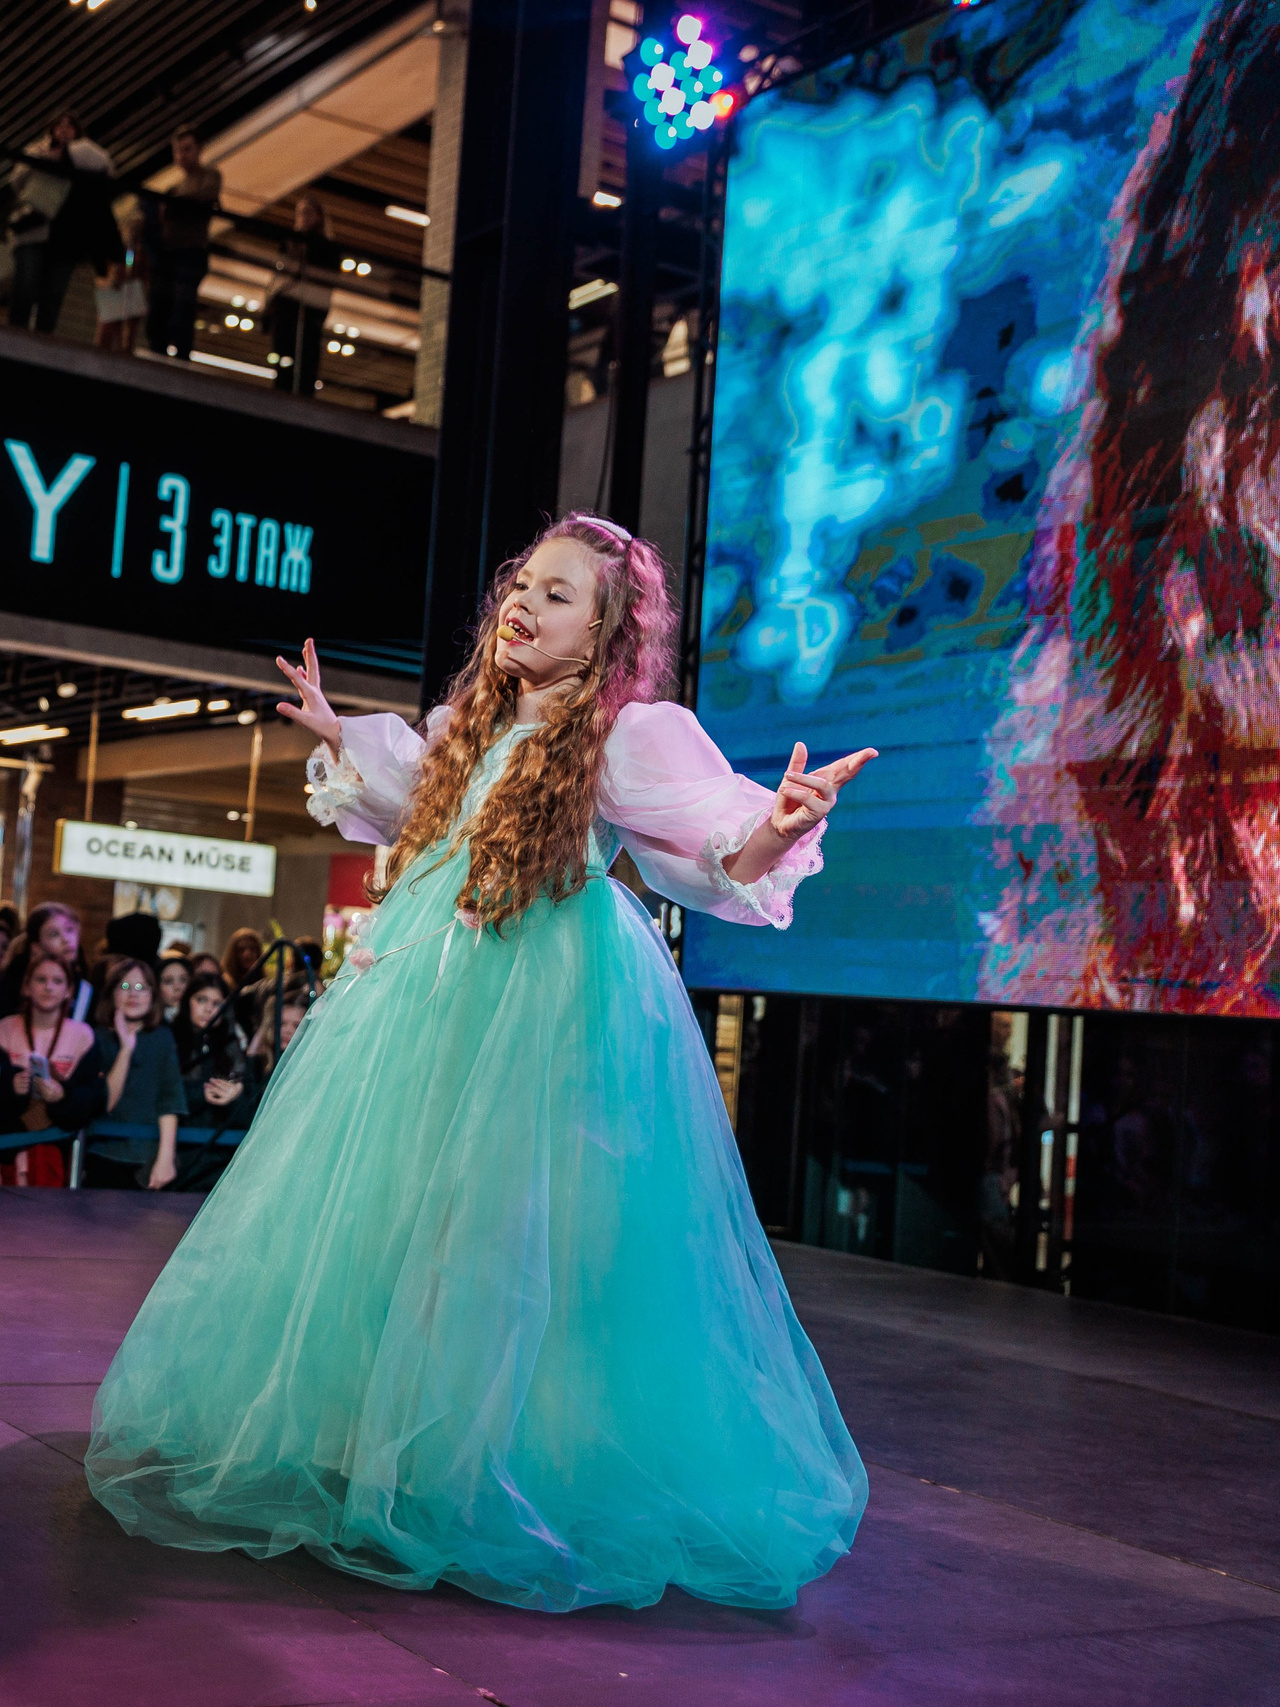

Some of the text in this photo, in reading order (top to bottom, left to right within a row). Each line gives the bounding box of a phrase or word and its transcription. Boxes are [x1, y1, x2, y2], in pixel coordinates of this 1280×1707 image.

[151, 472, 314, 594] 3 ЭТАЖ
[86, 836, 174, 863] OCEAN
